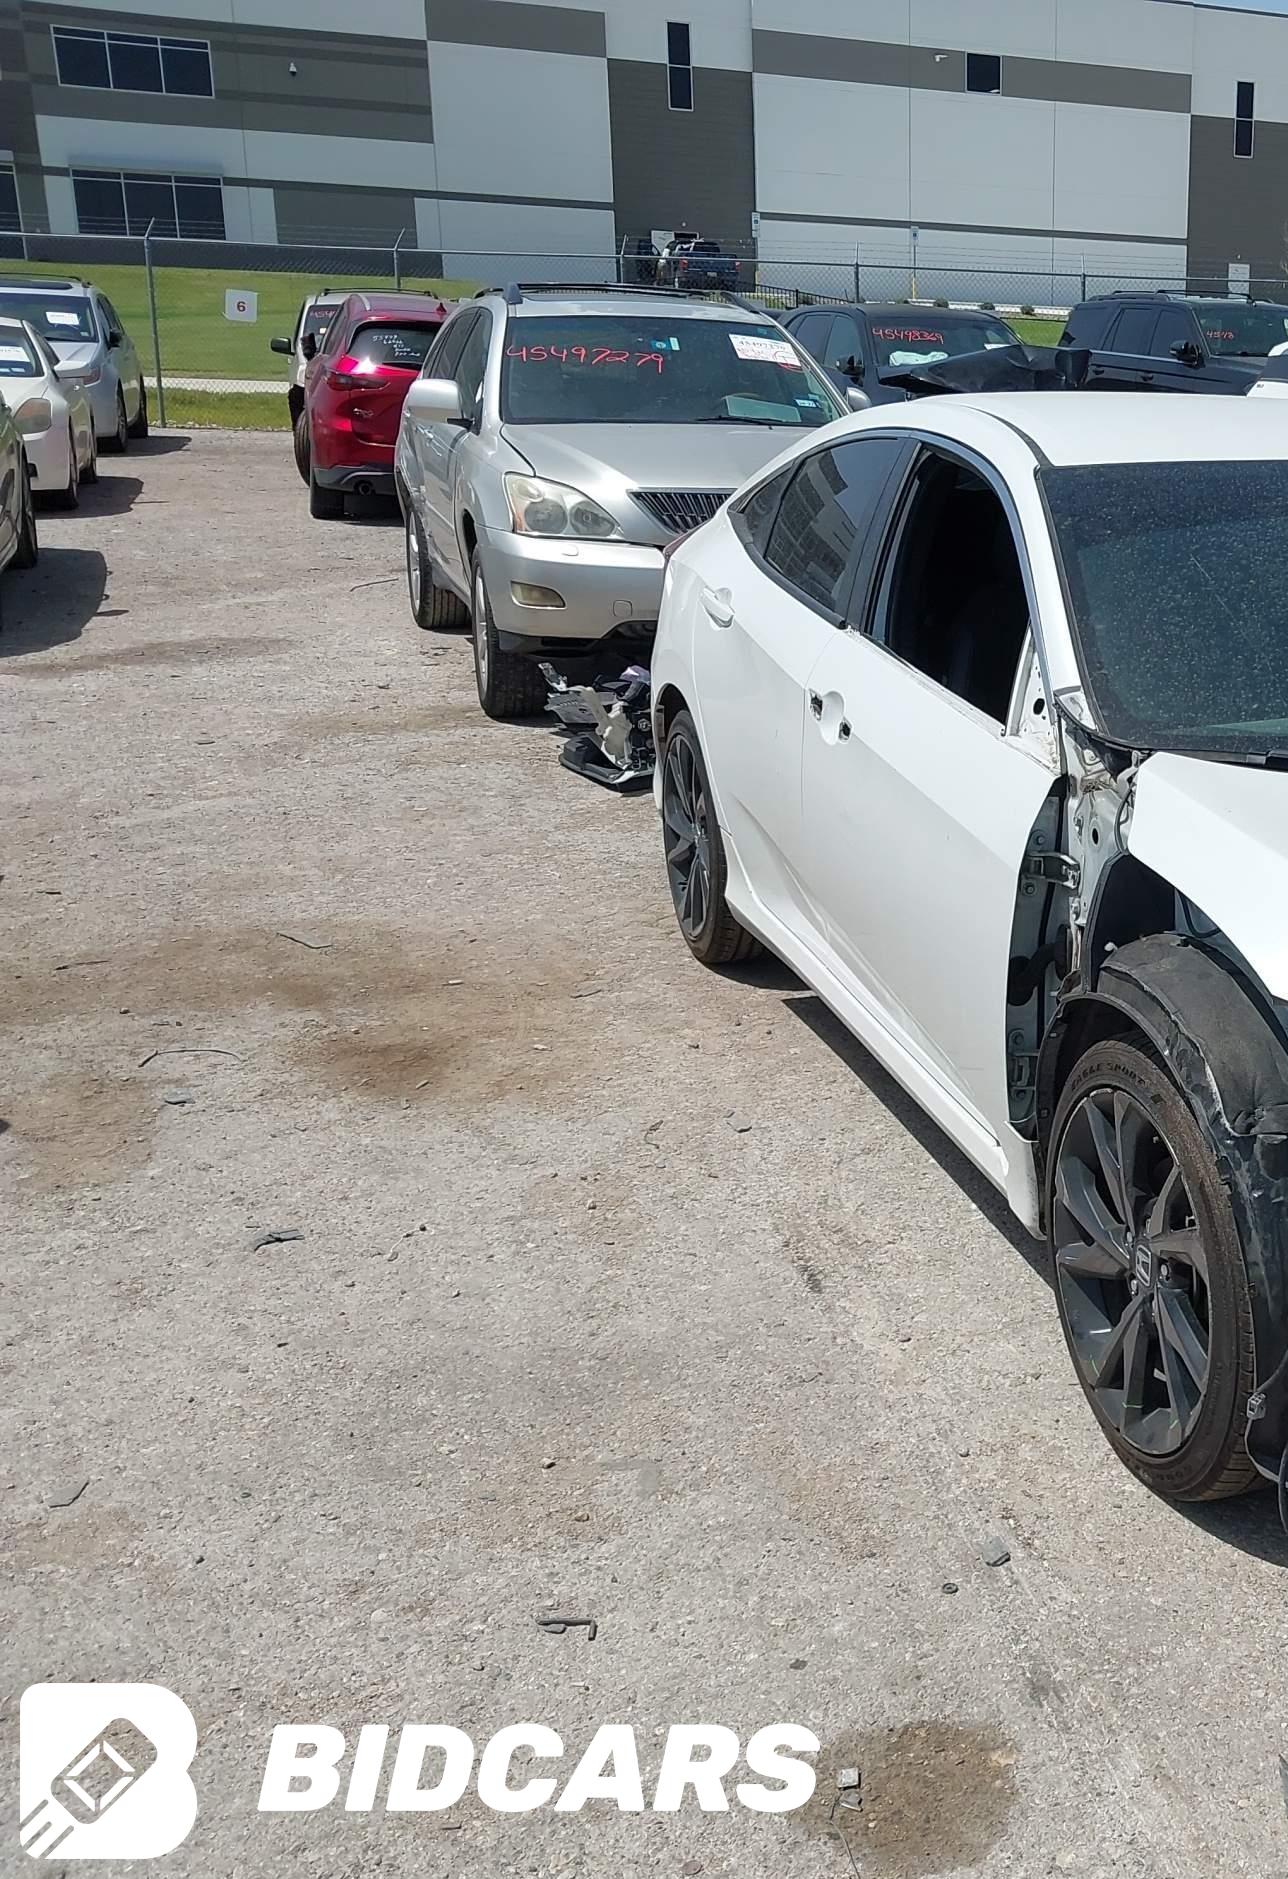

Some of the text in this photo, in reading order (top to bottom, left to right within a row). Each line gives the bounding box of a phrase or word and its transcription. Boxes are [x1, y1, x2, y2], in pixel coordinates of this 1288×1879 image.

[236, 301, 246, 312] 6
[872, 328, 944, 345] 45498369
[506, 344, 664, 374] 45497279
